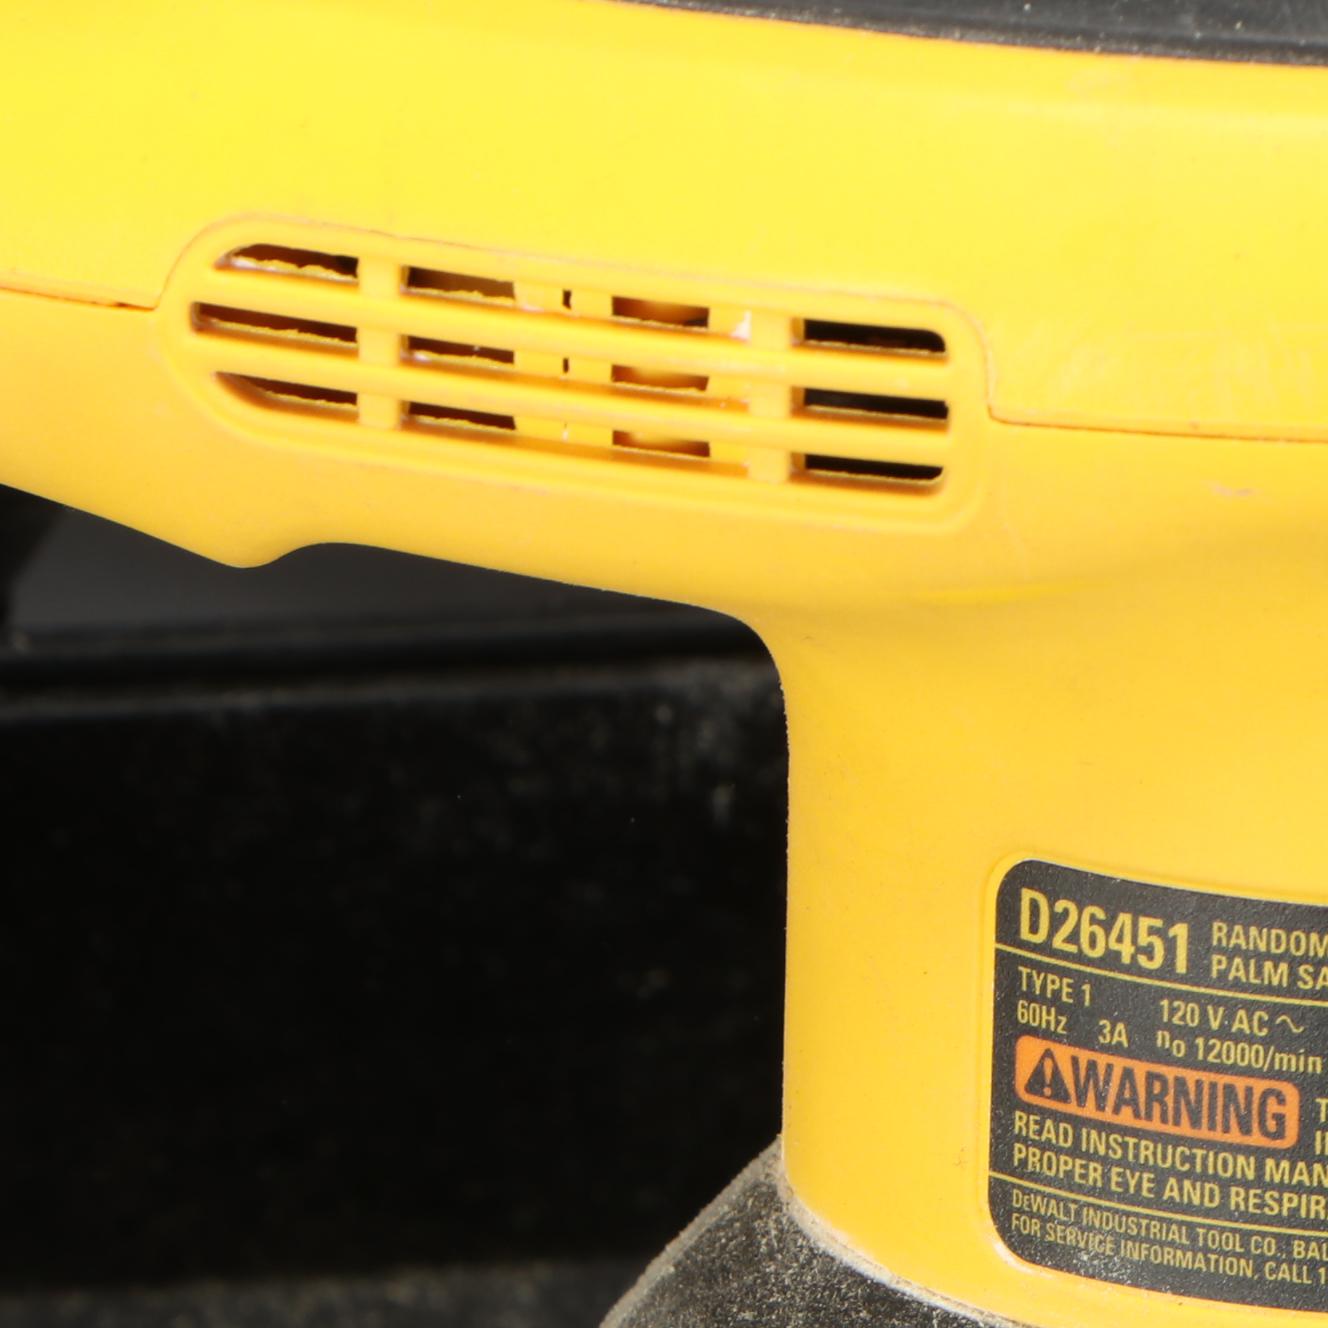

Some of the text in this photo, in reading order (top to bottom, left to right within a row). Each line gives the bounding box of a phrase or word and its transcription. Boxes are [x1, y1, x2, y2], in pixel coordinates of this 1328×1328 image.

[1020, 887, 1189, 974] D26451
[1018, 966, 1092, 1007] TYPE 1
[1211, 954, 1289, 989] PALM
[1016, 1001, 1068, 1034] 60Hz
[1099, 1019, 1129, 1048] 3A
[1195, 1037, 1322, 1074] 12000/min
[1160, 999, 1200, 1027] 120
[1231, 1008, 1269, 1037] AC
[1070, 1054, 1287, 1141] WARNING
[1013, 1144, 1102, 1189] PROPER
[1110, 1167, 1155, 1198] EYE
[1163, 1177, 1221, 1209] AND
[1014, 1111, 1073, 1151] READ
[1081, 1126, 1256, 1181] INSTRUCTION
[1011, 1213, 1041, 1236] FOR
[1045, 1222, 1115, 1256] SERVICE
[1120, 1240, 1259, 1280] INFORMATION,
[1264, 1261, 1312, 1284] CALL
[1082, 1208, 1190, 1245] INDUSTRIAL
[1196, 1228, 1245, 1253] TOOL
